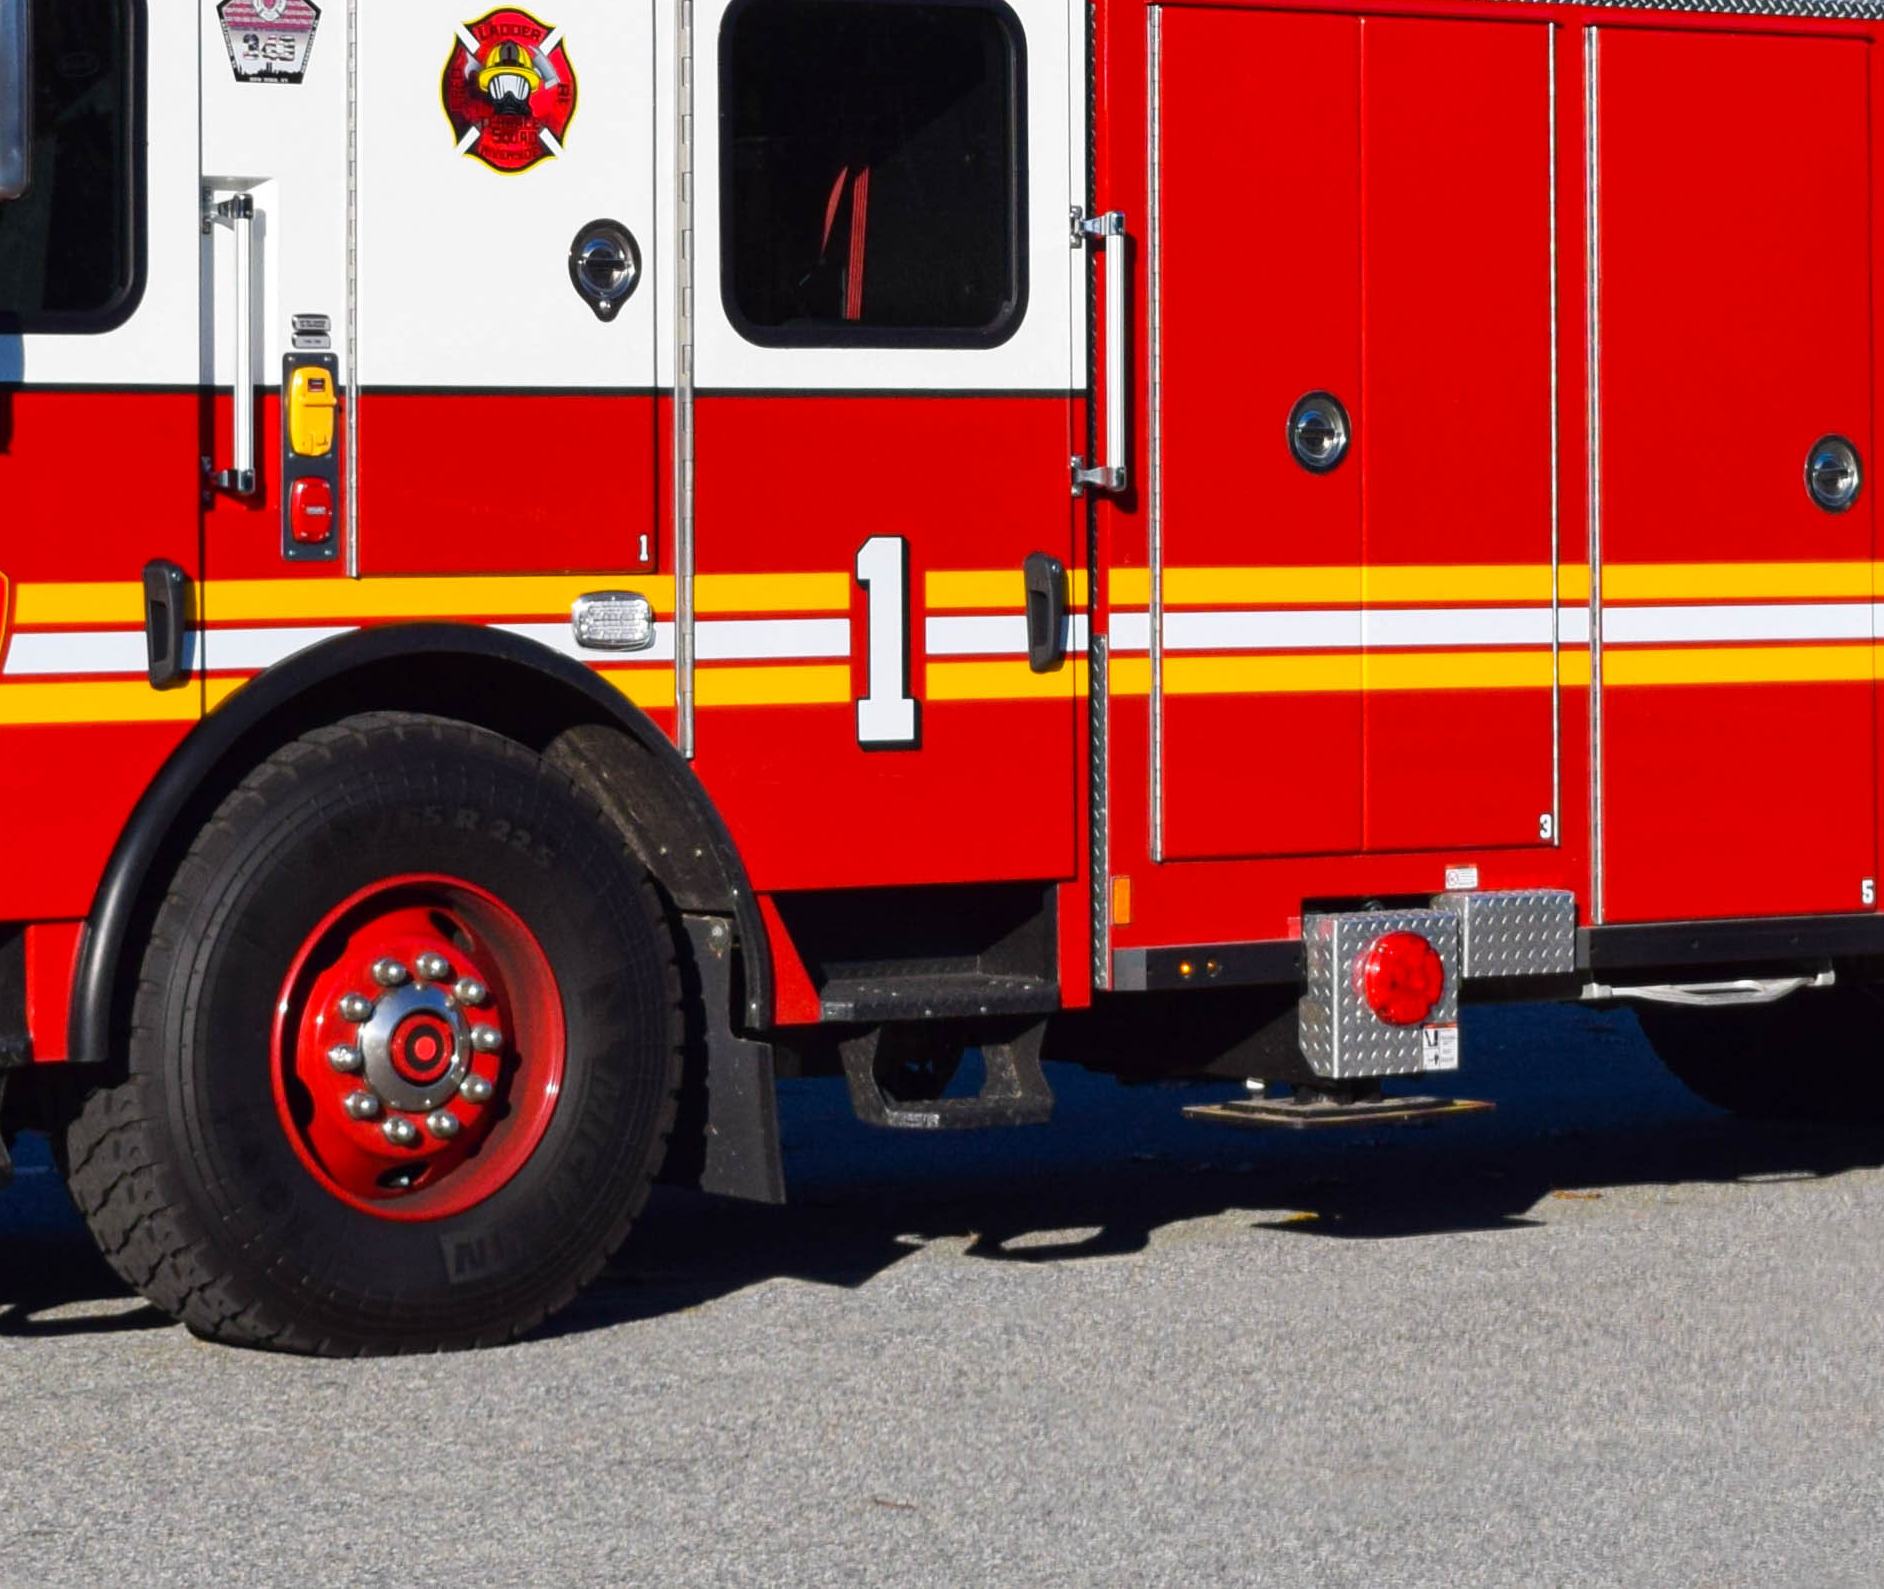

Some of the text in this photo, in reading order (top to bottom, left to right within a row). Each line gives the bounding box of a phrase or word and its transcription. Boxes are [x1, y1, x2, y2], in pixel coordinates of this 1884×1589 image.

[479, 22, 541, 41] LADDER
[855, 534, 922, 751] 1
[1538, 813, 1553, 841] 3
[1860, 879, 1875, 907] 5
